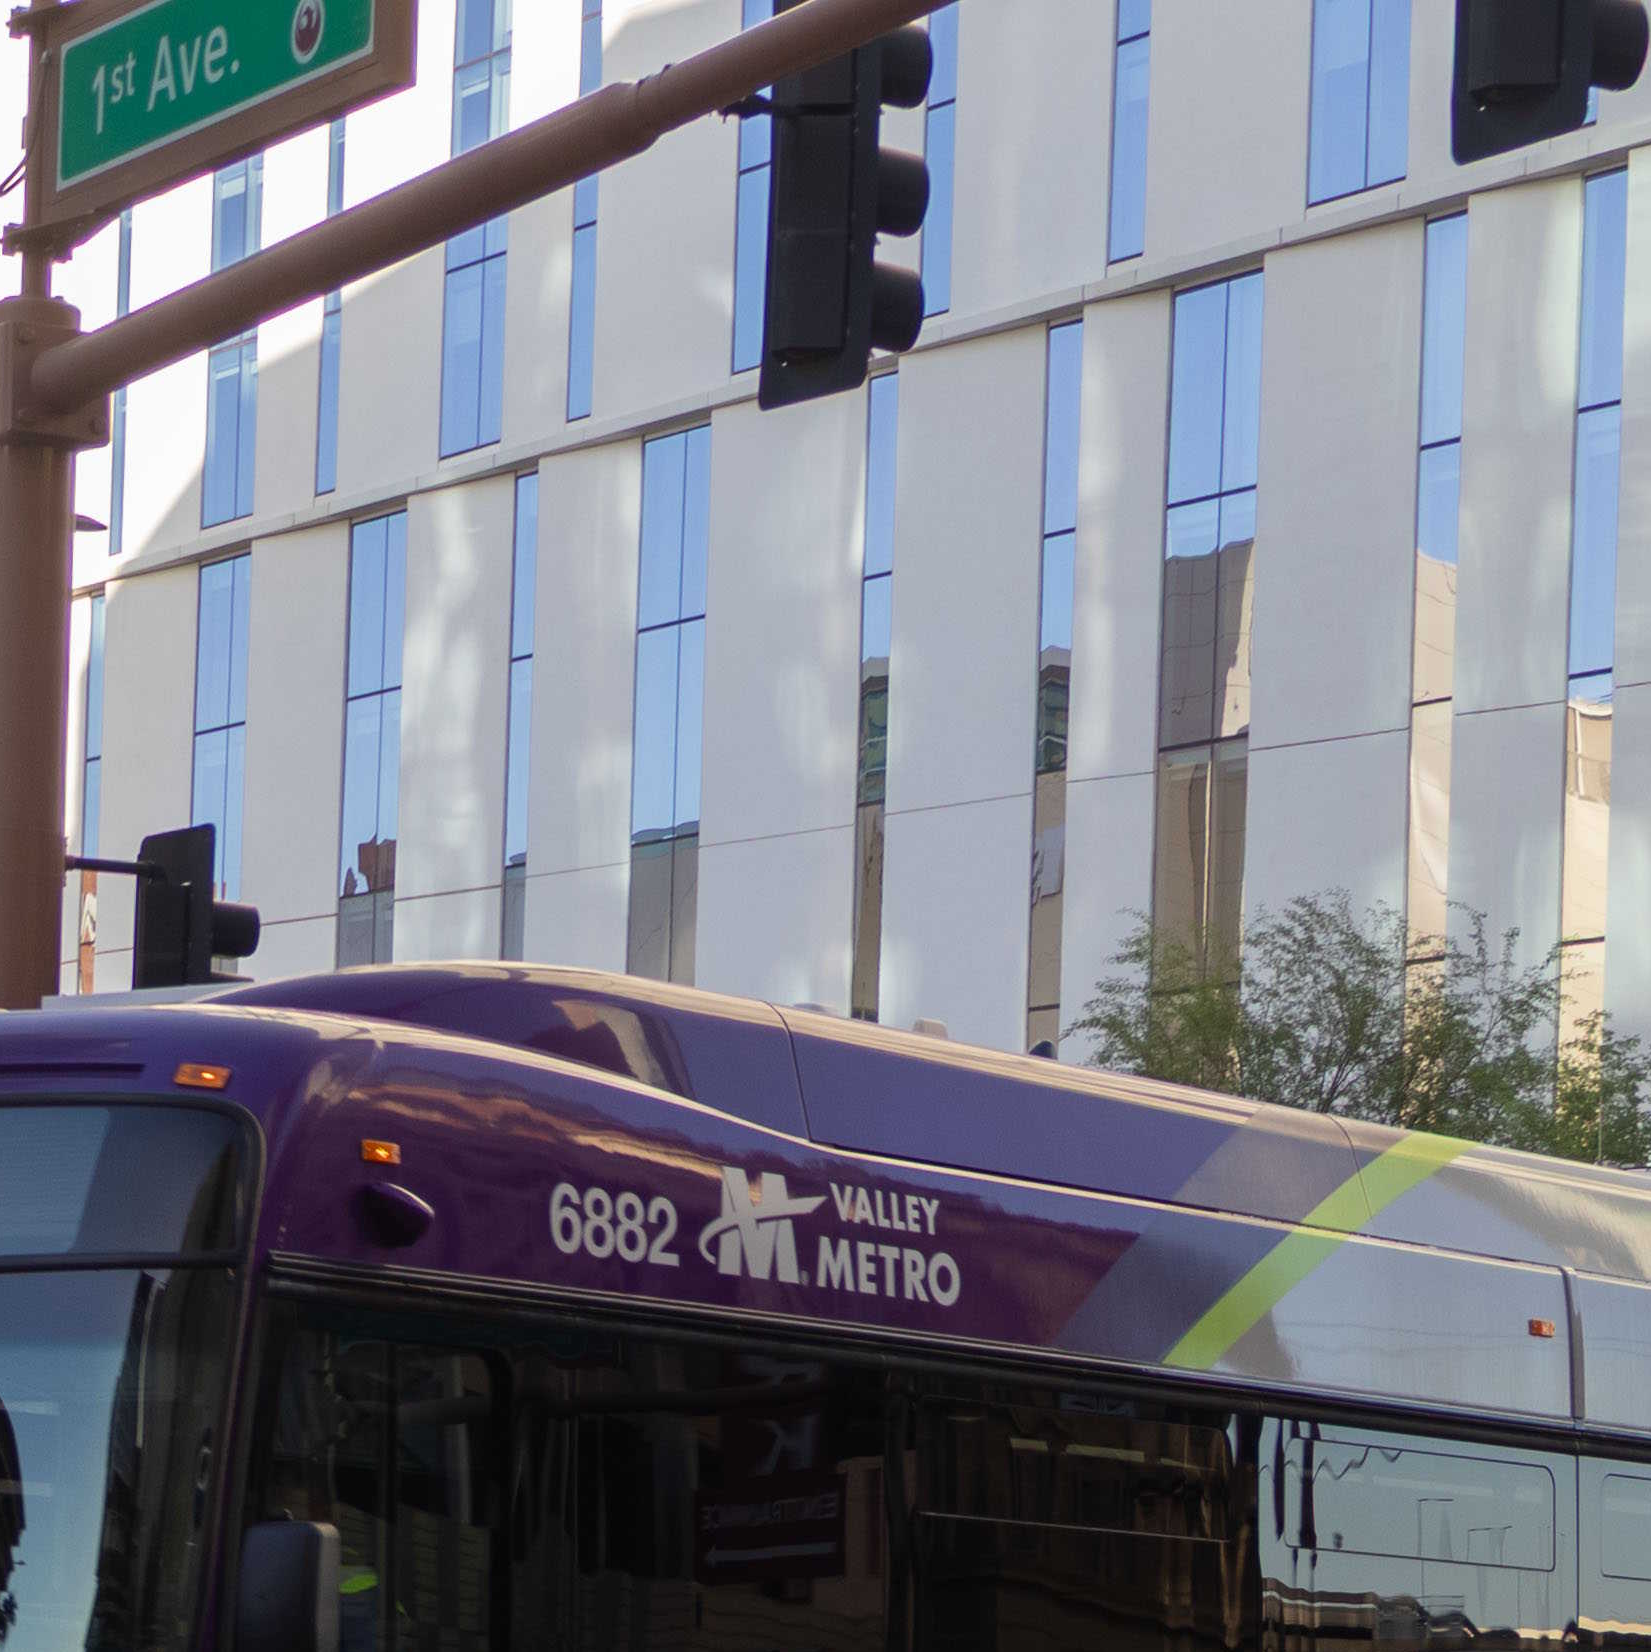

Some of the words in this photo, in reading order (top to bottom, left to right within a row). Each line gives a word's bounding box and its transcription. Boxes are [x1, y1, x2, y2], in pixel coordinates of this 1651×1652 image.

[90, 49, 137, 135] 1st
[146, 23, 241, 113] Ave.
[548, 1181, 680, 1268] 6882
[828, 1182, 940, 1237] VALLEY
[817, 1235, 962, 1307] METRO
